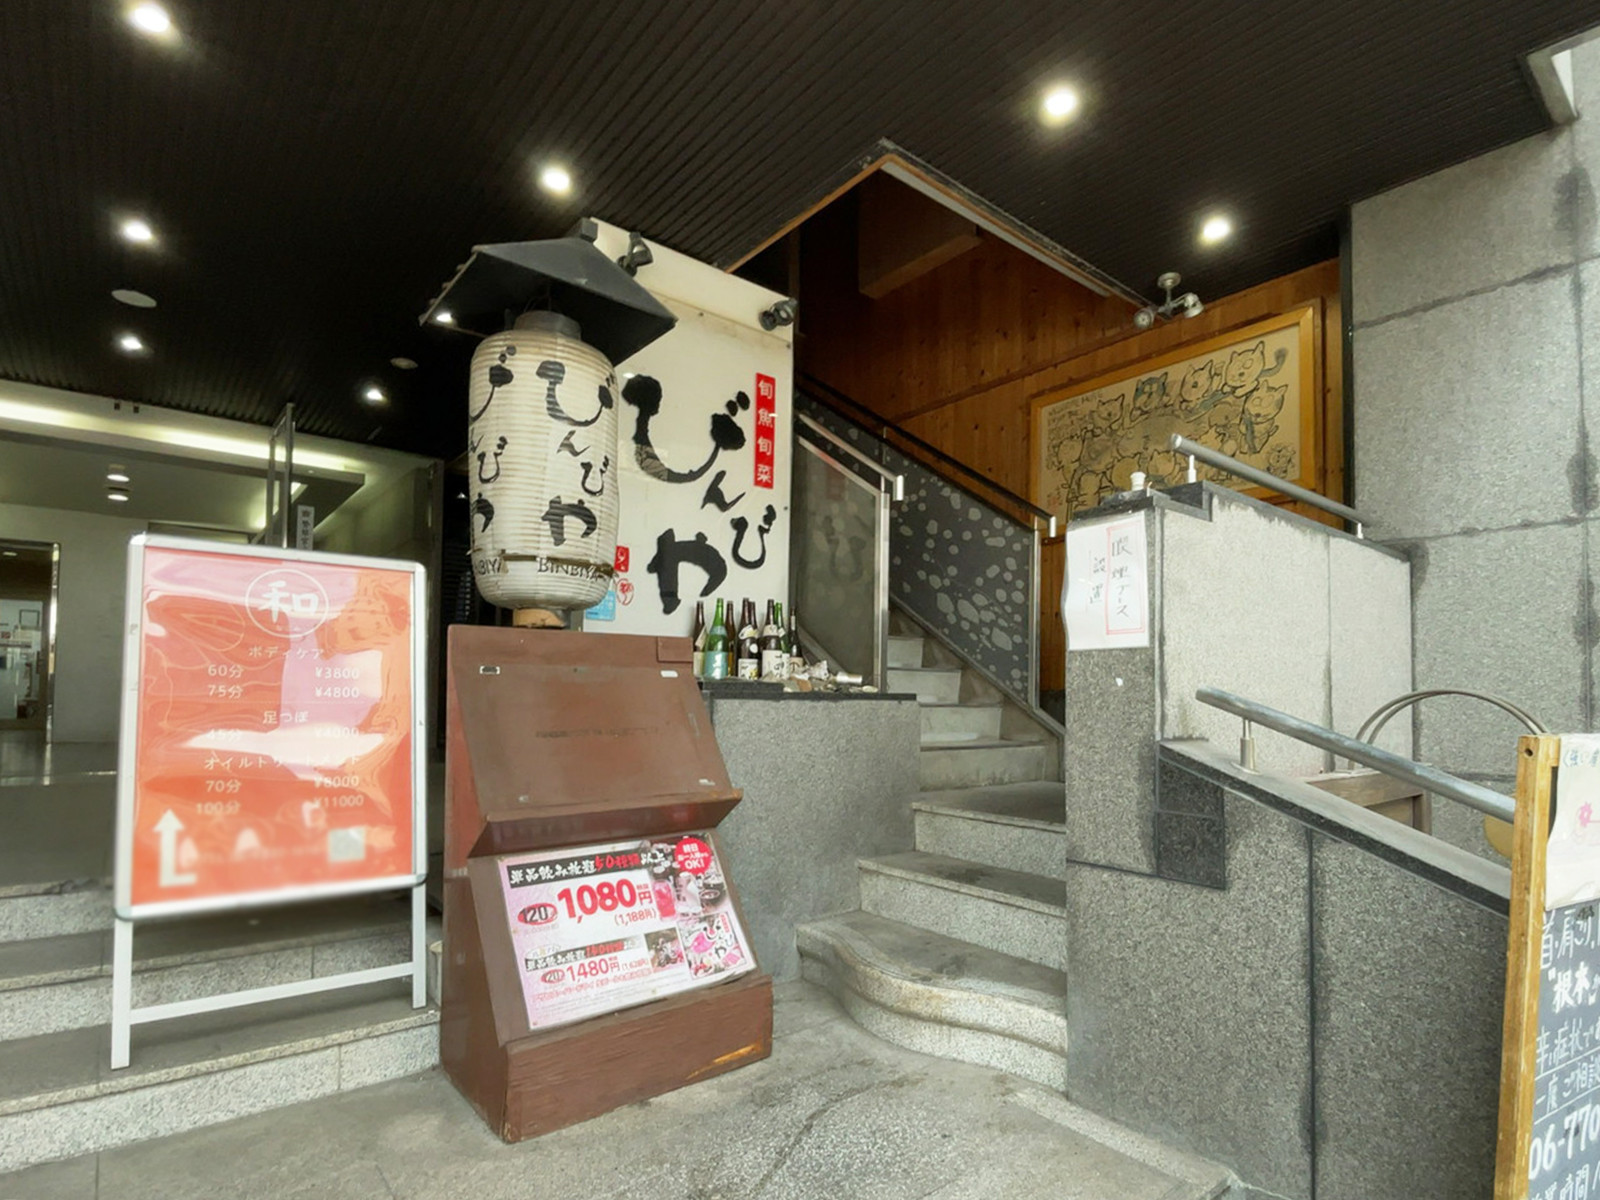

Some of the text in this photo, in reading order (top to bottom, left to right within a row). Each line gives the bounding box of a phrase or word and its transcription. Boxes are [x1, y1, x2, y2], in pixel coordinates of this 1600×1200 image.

[757, 380, 774, 484] 旬魚旬菜
[259, 580, 319, 622] 和
[207, 664, 360, 679] 60分 ¥3800
[207, 684, 360, 699] 75分 ¥4800
[205, 776, 360, 794] 70分 ¥8000
[195, 800, 242, 816] 100分
[684, 857, 705, 869] OK!
